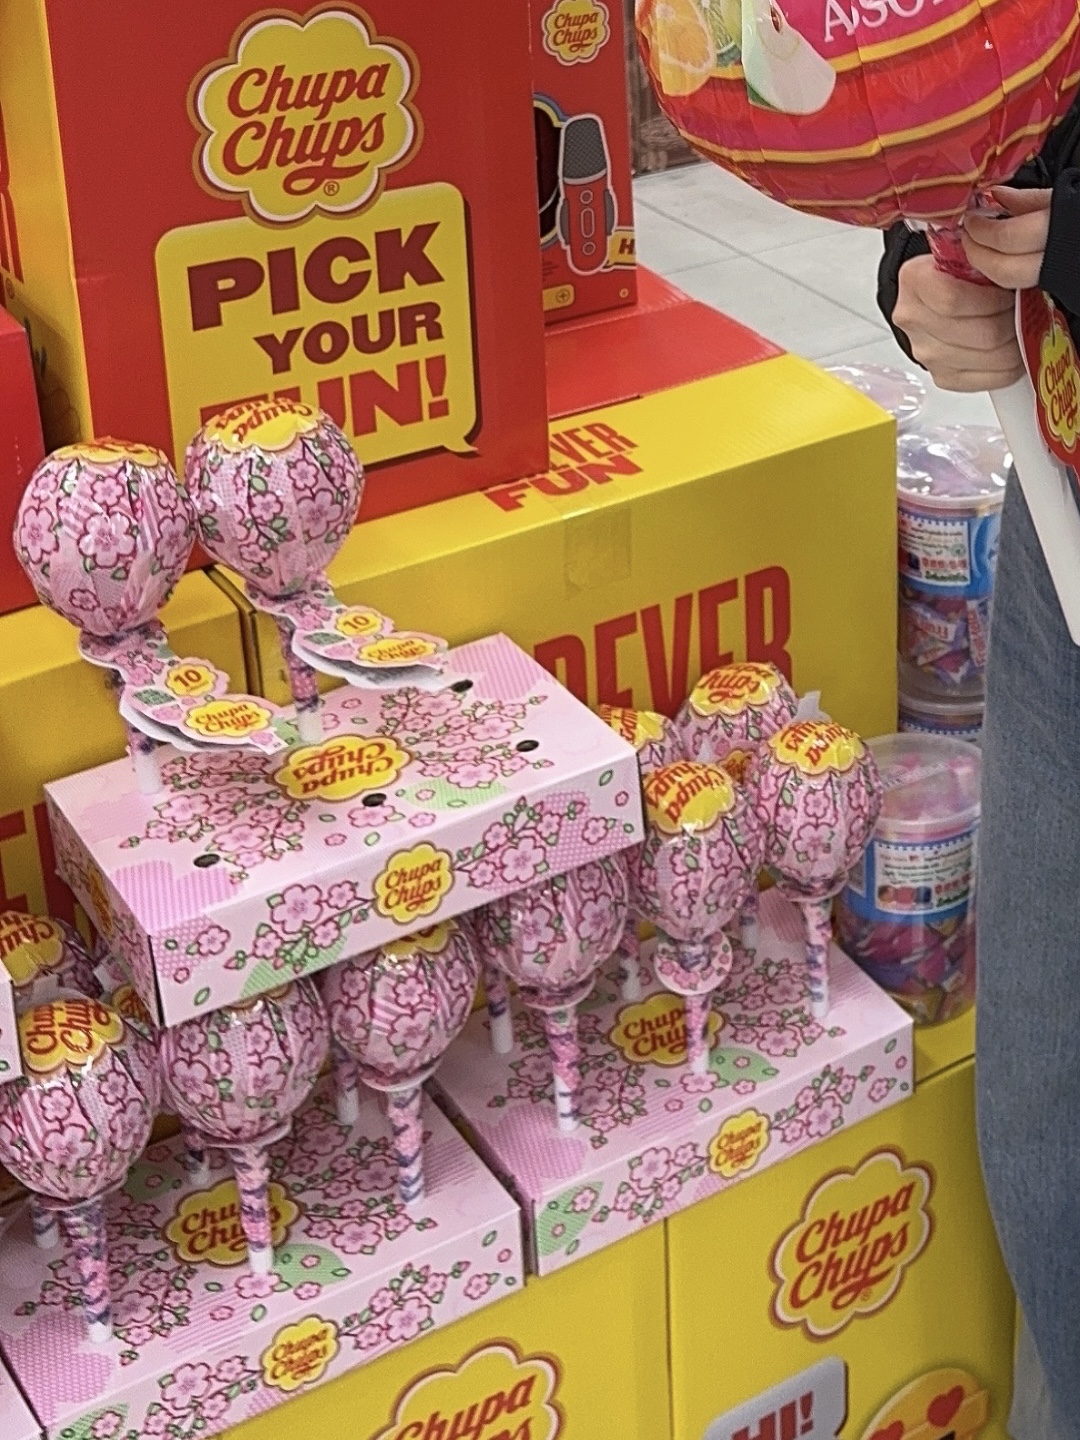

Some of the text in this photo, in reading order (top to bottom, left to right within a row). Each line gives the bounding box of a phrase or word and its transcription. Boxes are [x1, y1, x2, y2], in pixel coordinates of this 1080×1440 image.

[552, 28, 599, 53] Chups
[553, 12, 599, 32] Chupa
[227, 62, 390, 120] Chupa
[222, 112, 388, 196] Chups
[187, 221, 444, 332] PICK
[253, 301, 444, 375] YOUR
[1045, 345, 1071, 395] Chupa
[1050, 372, 1078, 430] Chups
[483, 453, 644, 512] FUN
[343, 614, 370, 631] 10
[366, 639, 416, 659] Chupa
[174, 669, 202, 688] 10
[195, 702, 249, 725] Chupa
[291, 741, 388, 782] Chups
[300, 754, 395, 796] Chupa
[384, 876, 442, 913] Chups
[385, 858, 443, 890] Chupa
[623, 1009, 686, 1041] Chup
[795, 1181, 916, 1263] Chupa
[789, 1221, 911, 1310] Chups
[273, 1327, 329, 1360] Chupa
[731, 1390, 815, 1440] HI!
